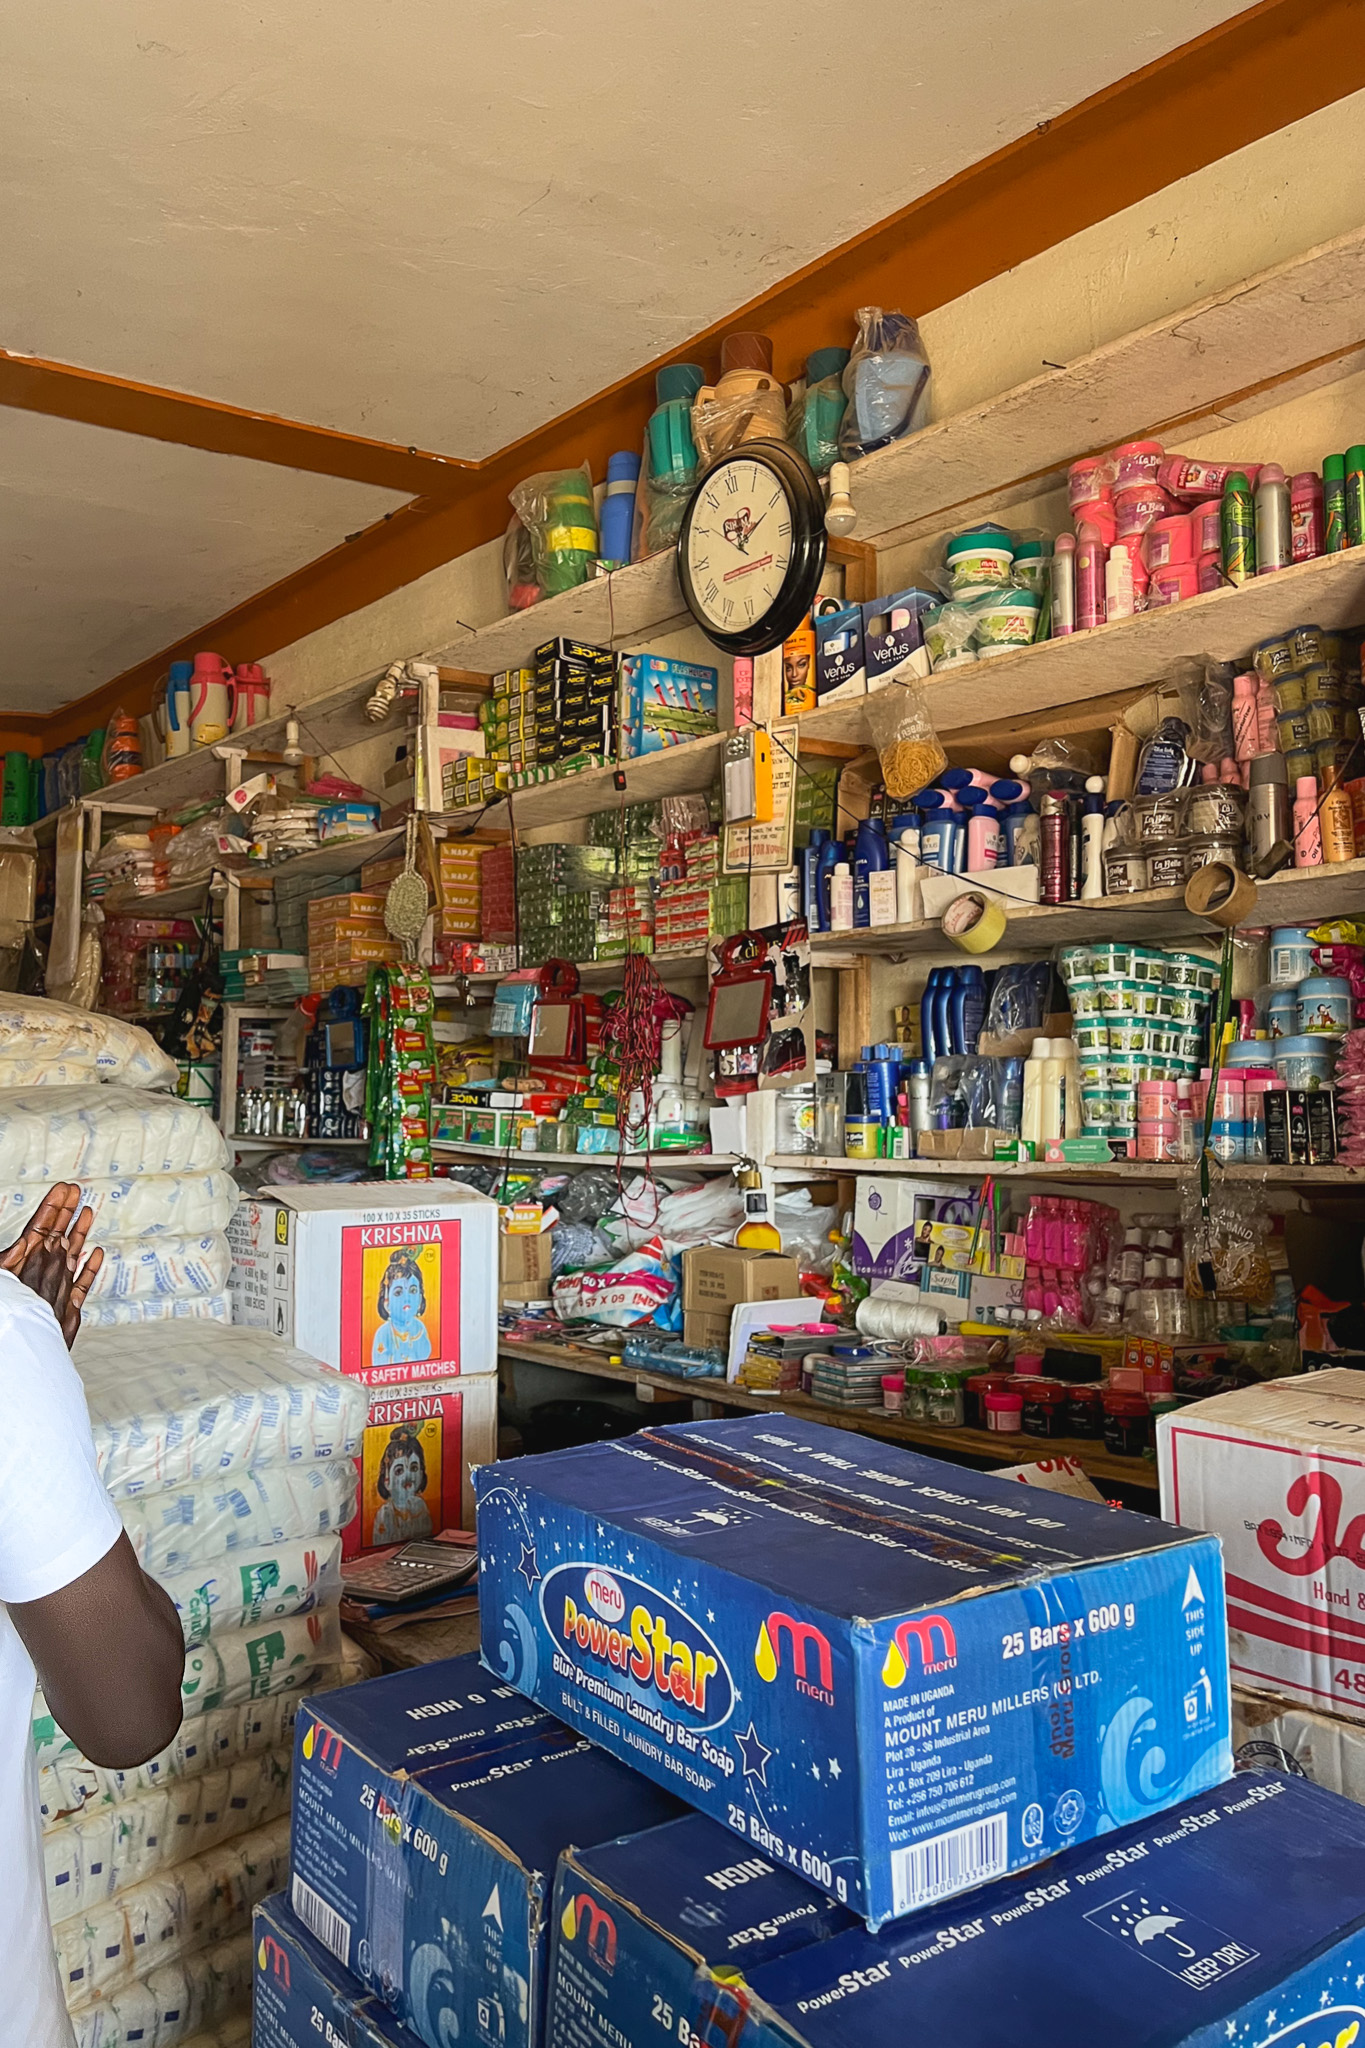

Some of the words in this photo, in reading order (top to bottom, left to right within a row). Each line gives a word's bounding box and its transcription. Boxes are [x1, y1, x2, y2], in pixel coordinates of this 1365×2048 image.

[363, 1213, 376, 1223] 100
[377, 1212, 383, 1222] X
[385, 1212, 394, 1222] 10
[396, 1211, 401, 1220] X
[402, 1210, 412, 1220] 35
[413, 1208, 441, 1220] STICKS
[360, 1224, 443, 1246] KRISHNA
[371, 1366, 410, 1384] SAFETY
[412, 1361, 456, 1378] MATCHES
[808, 1452, 858, 1470] THAN
[855, 1470, 914, 1487] MORE
[911, 1486, 978, 1506] STACK
[976, 1504, 1027, 1518] NOT
[589, 1579, 623, 1610] meru
[1313, 1581, 1350, 1607] Hand
[1184, 1608, 1205, 1624] THIS
[1002, 1632, 1025, 1660] 25
[1030, 1621, 1071, 1652] Bars
[1088, 1603, 1120, 1633] 600
[1124, 1602, 1136, 1629] g
[562, 1595, 719, 1713] PowerStar
[1190, 1643, 1202, 1657] UP
[467, 1693, 487, 1704] 6
[796, 1678, 835, 1706] meru
[883, 1697, 909, 1712] MADE
[910, 1694, 920, 1706] IN
[921, 1684, 956, 1703] UGANDA
[406, 1700, 464, 1720] HIGH
[552, 1653, 576, 1680] Blue
[575, 1666, 626, 1710] Premium
[626, 1699, 675, 1744] Laundry
[676, 1723, 700, 1752] Bar
[701, 1746, 736, 1777] Soap
[884, 1718, 942, 1748] MOUNT
[946, 1704, 988, 1730] MERU
[991, 1686, 1050, 1716] MILLERS
[1074, 1670, 1102, 1689] LTD.
[884, 1716, 892, 1728] A
[893, 1710, 926, 1727] Product
[926, 1704, 936, 1718] of
[406, 1729, 486, 1756] PowerStar
[592, 1709, 620, 1736] FILLED
[622, 1728, 663, 1763] LAUNDRY
[664, 1756, 684, 1776] BAR
[885, 1750, 904, 1764] Plot
[934, 1728, 972, 1750] Industrial
[972, 1724, 990, 1738] Area
[450, 1758, 534, 1792] PowerStar
[886, 1766, 904, 1780] Lira
[910, 1754, 942, 1772] Uganda
[908, 1776, 925, 1790] Box
[926, 1770, 941, 1784] 709
[942, 1765, 958, 1778] Lira
[964, 1754, 993, 1772] Uganda
[298, 1787, 324, 1816] MOUNT
[888, 1798, 904, 1811] Tel:
[928, 1784, 943, 1798] 750
[944, 1779, 960, 1794] 706
[960, 1774, 975, 1788] 612
[360, 1784, 376, 1811] 25
[413, 1828, 438, 1862] 600
[438, 1852, 449, 1876] g
[888, 1812, 916, 1828] Email:
[888, 1828, 911, 1843] Web:
[728, 1803, 746, 1834] 25
[750, 1816, 784, 1858] Bars
[801, 1848, 832, 1888] 600
[836, 1874, 848, 1902] g
[704, 1858, 775, 1891] HIGH
[797, 1960, 892, 2014] PowerStar
[898, 1916, 987, 1970] PowerStar
[990, 1878, 1072, 1927] PowerStar
[1075, 1840, 1150, 1886] PowerStar
[1153, 1808, 1221, 1848] PowerStar
[1223, 1780, 1288, 1816] PowerStar
[727, 1904, 818, 1950] PowerStar
[1179, 1956, 1222, 1985] KEEP
[1219, 1942, 1250, 1966] DRY
[557, 1972, 596, 2018] MOUNT
[310, 2005, 324, 2033] 25
[651, 1994, 674, 2030] 25
